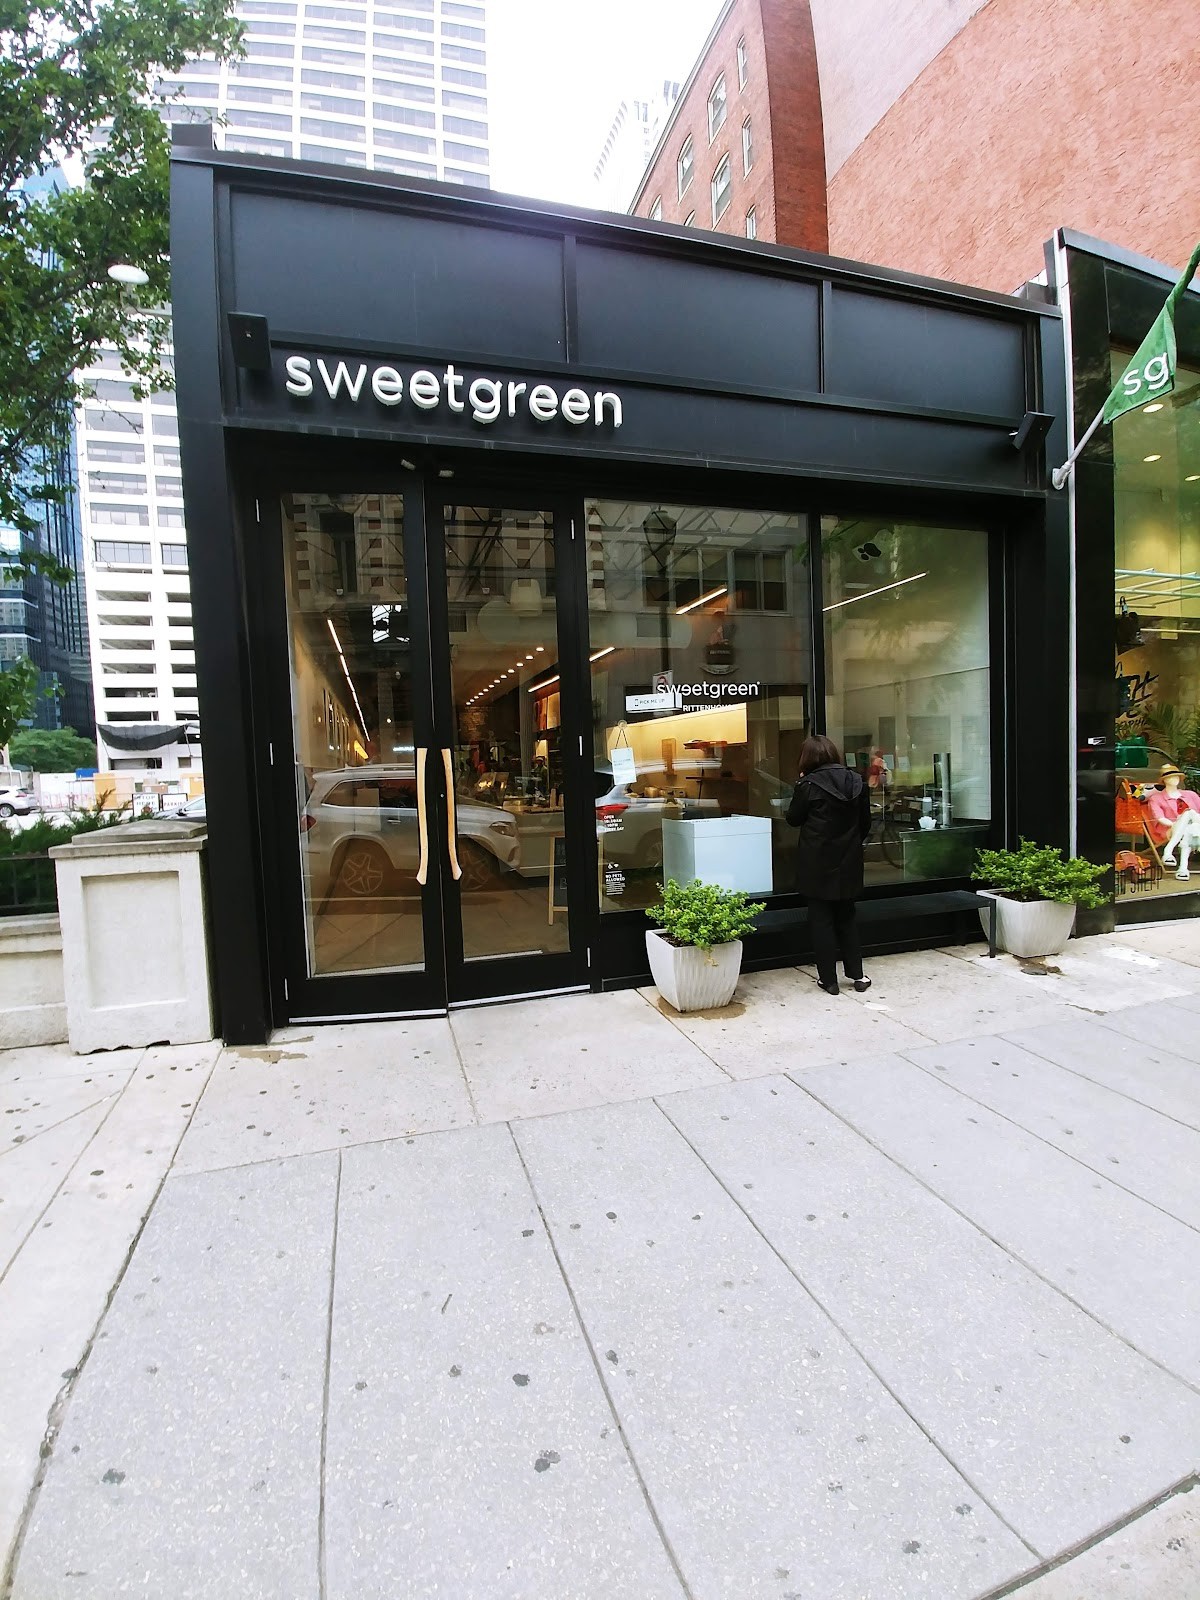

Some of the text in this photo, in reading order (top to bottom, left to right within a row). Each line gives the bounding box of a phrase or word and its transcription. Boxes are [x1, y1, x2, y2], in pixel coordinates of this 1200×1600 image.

[1122, 352, 1170, 396] sg
[284, 354, 624, 428] sweetgreen
[656, 681, 758, 698] sweetgreen
[682, 704, 738, 712] RITTENHO
